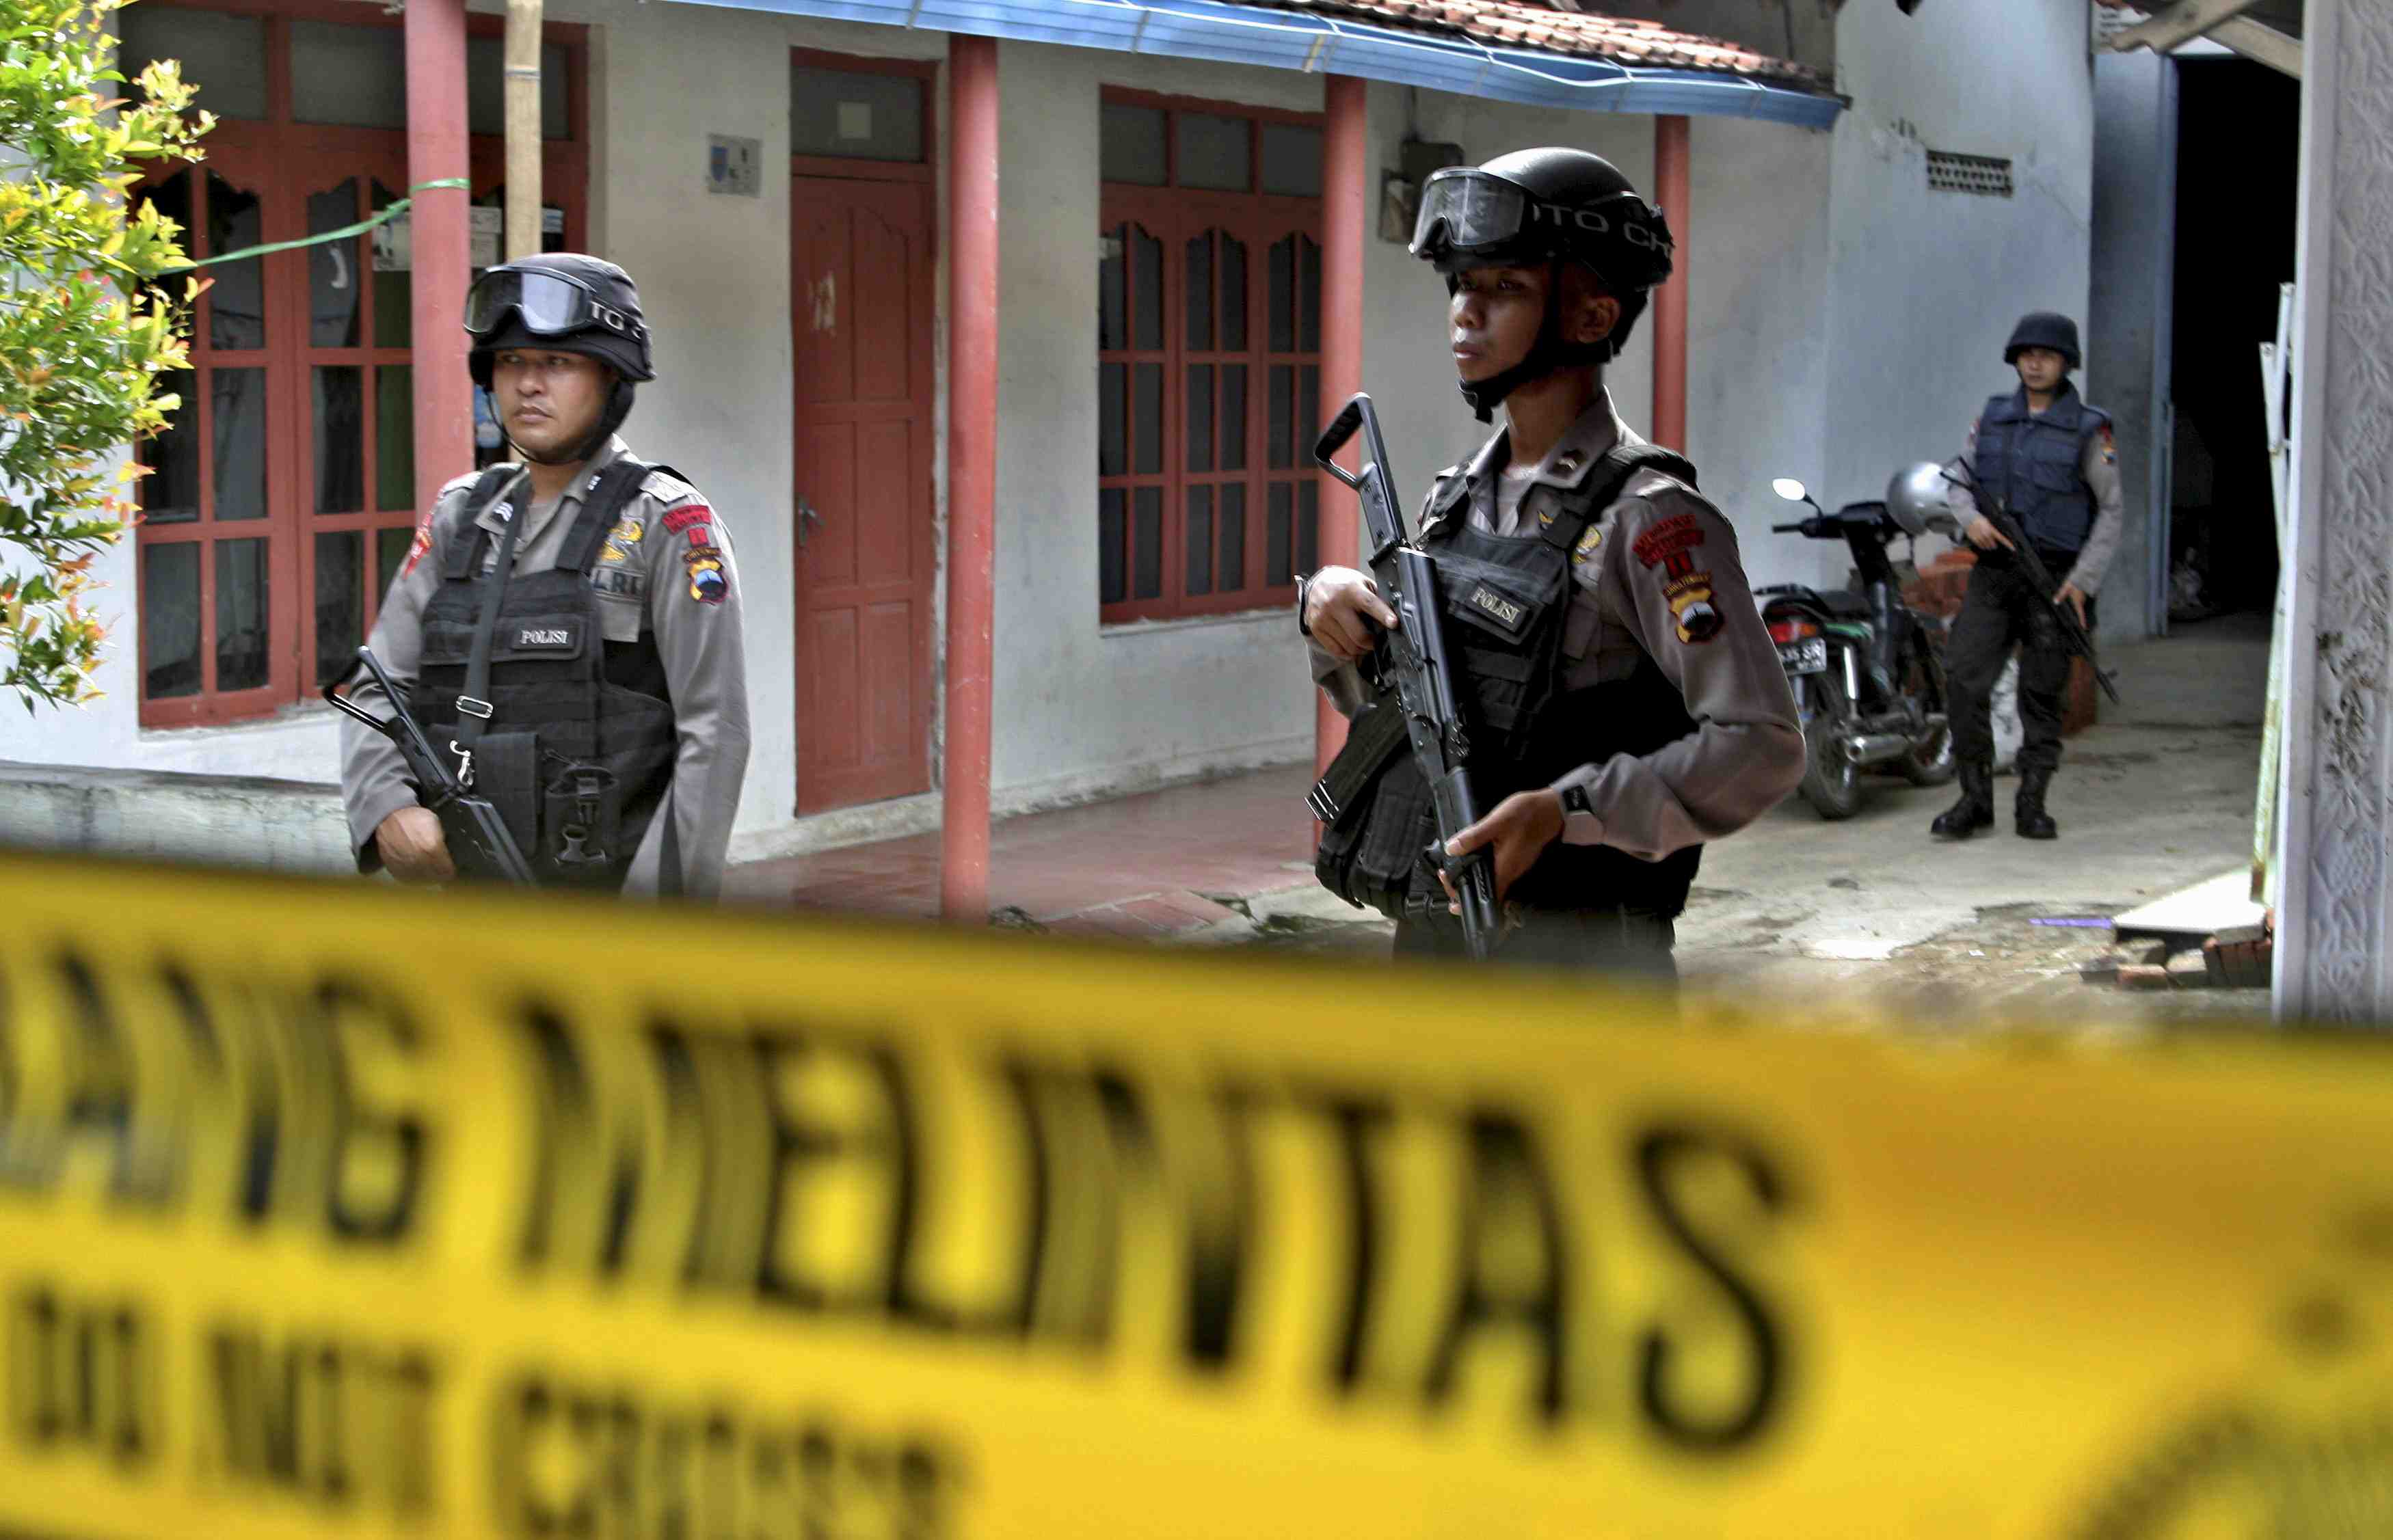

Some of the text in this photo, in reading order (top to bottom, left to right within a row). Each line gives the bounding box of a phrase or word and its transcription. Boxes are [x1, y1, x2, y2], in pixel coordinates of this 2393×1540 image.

[1471, 586, 1521, 623] POLISI
[520, 629, 569, 645] POLISI
[0, 940, 1805, 1456] ANG MELINTAS
